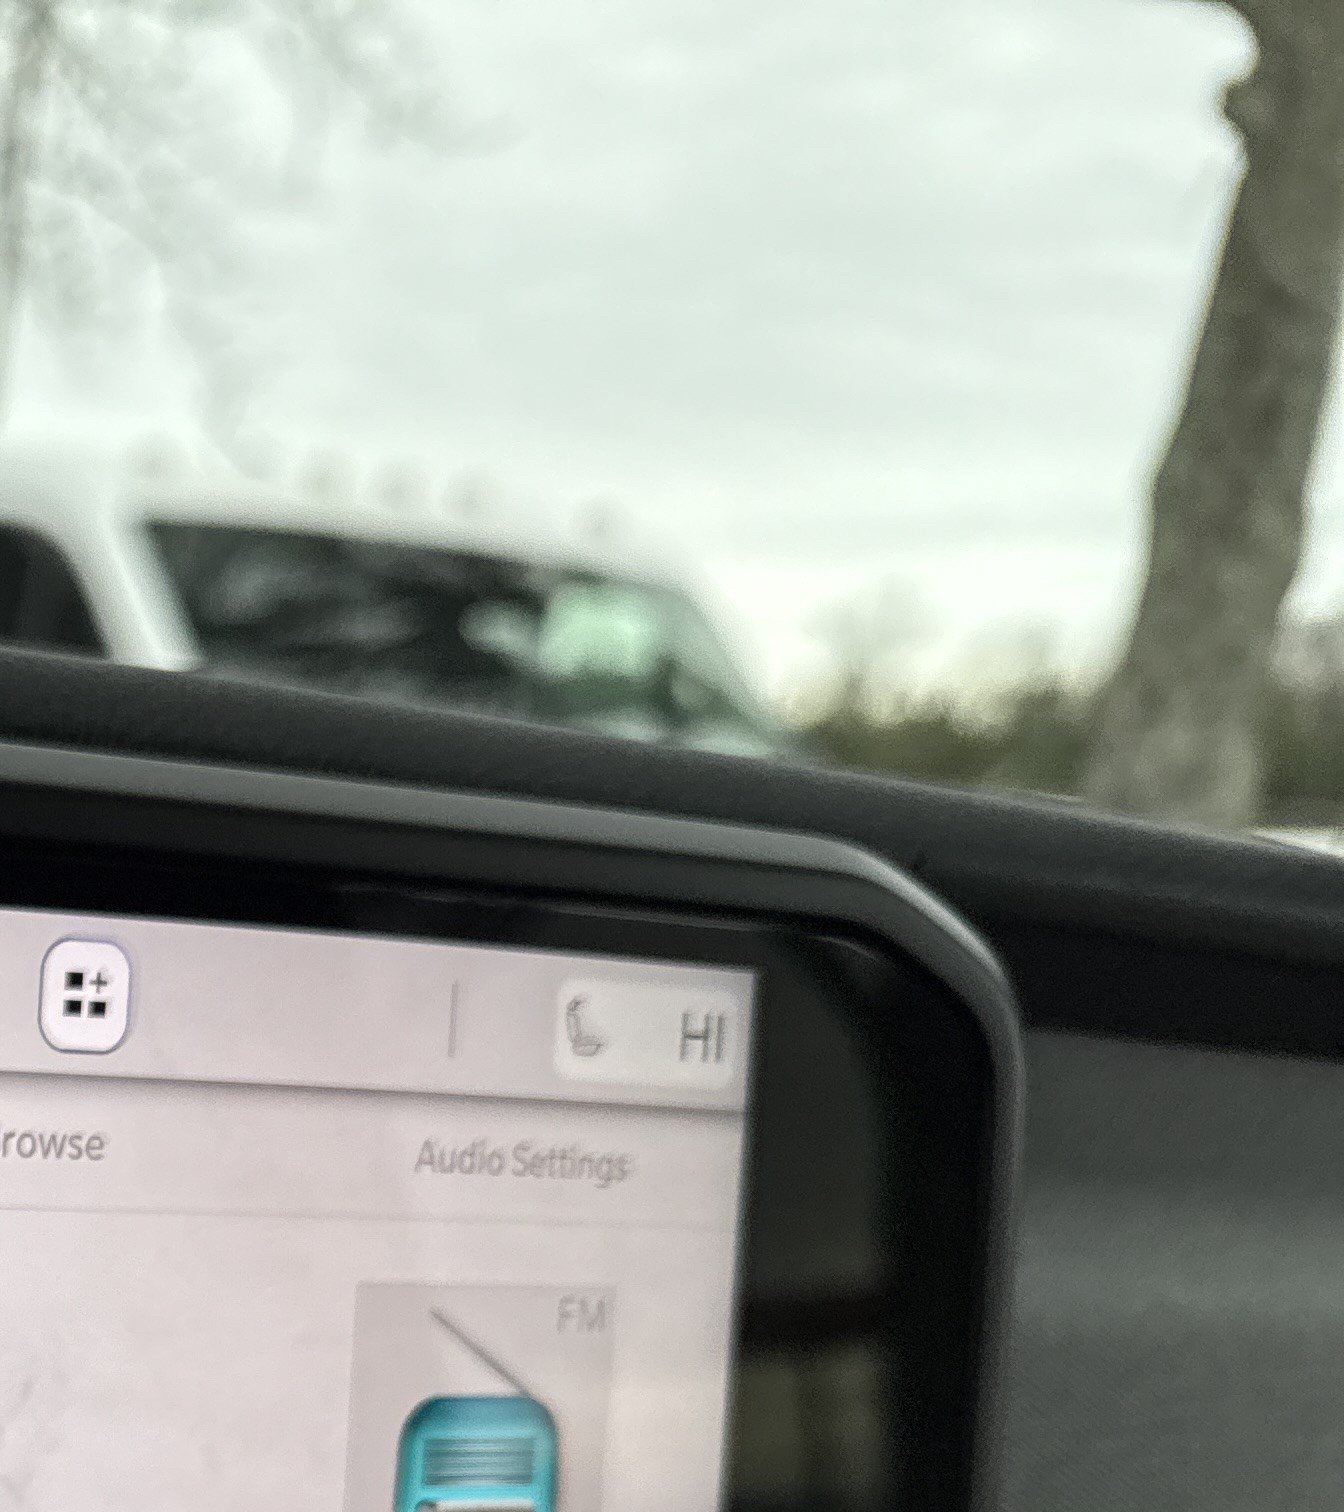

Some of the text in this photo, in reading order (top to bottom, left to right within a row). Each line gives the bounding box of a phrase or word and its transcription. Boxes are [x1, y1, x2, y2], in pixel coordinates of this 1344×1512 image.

[679, 1012, 725, 1062] HI
[415, 1139, 633, 1189] Audio Settings
[557, 1297, 607, 1332] FM
